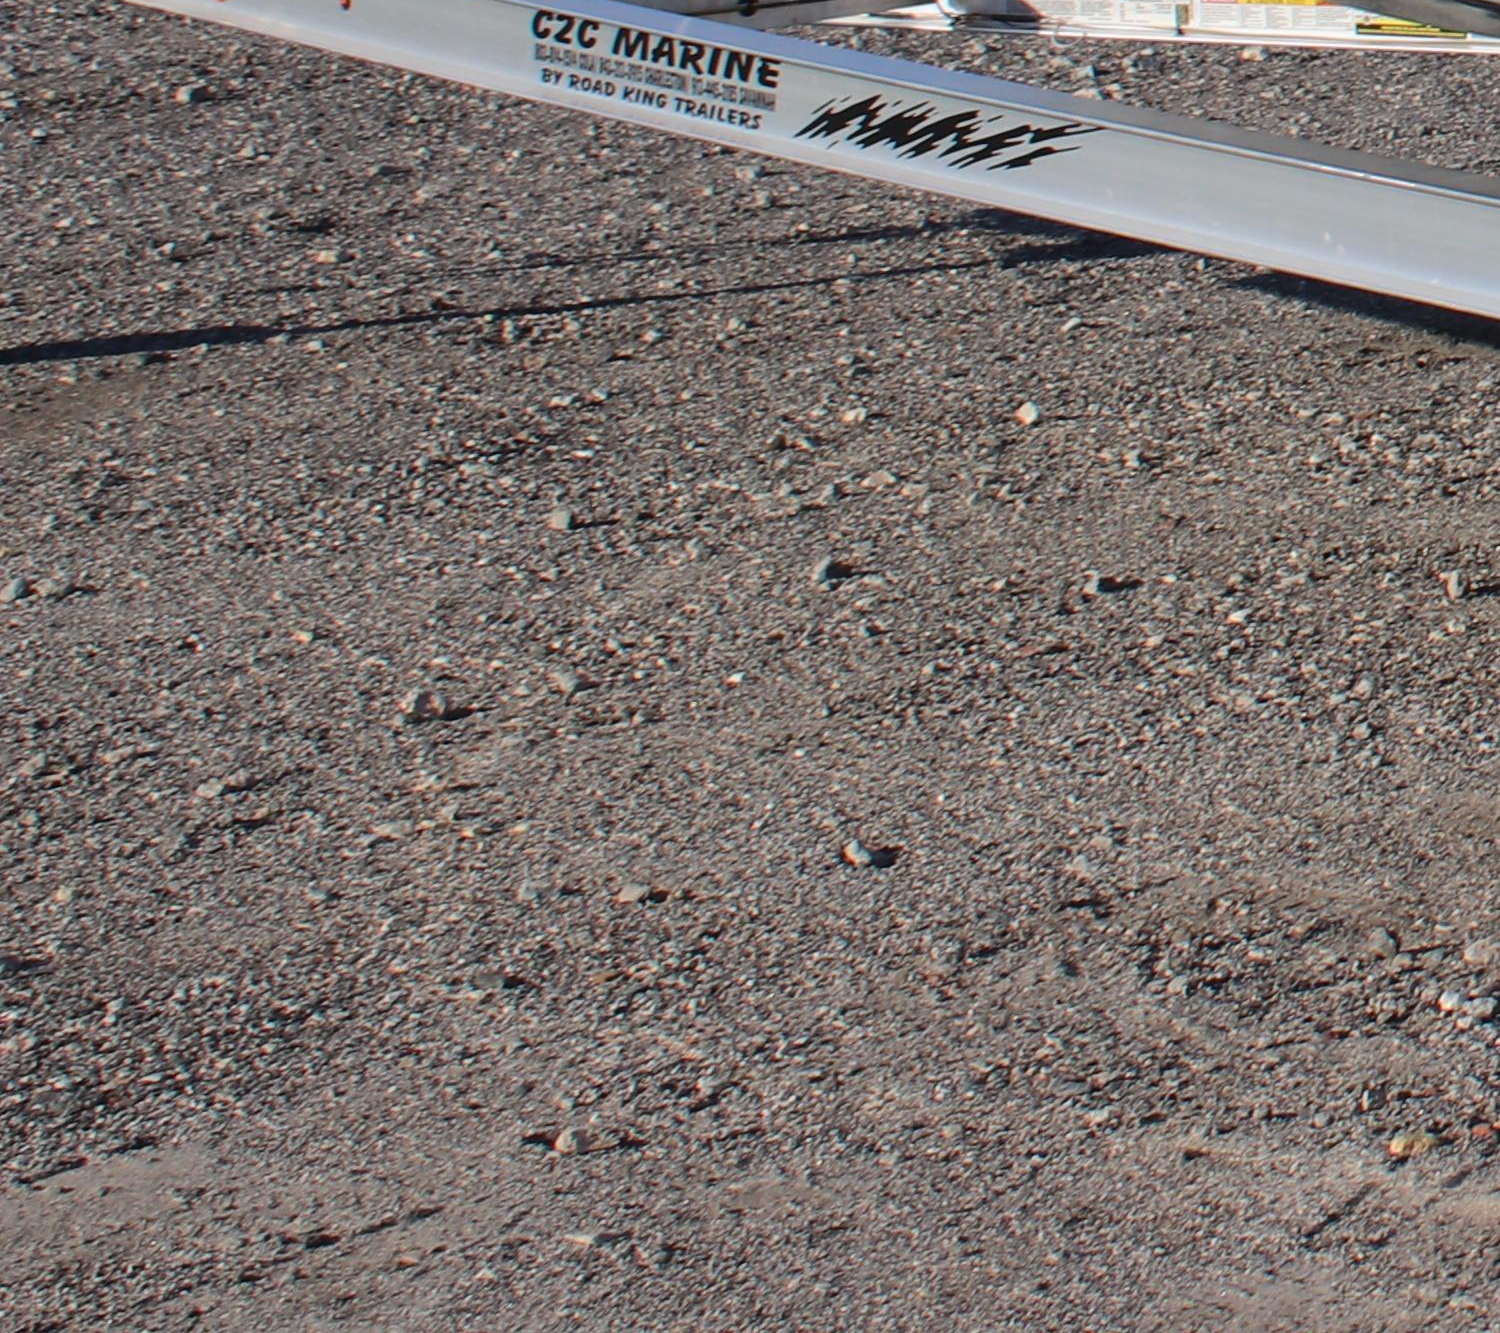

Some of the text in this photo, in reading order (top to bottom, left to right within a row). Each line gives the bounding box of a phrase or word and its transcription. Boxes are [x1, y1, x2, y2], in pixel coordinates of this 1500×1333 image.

[532, 9, 600, 49] C2C
[612, 27, 782, 89] MARINE
[541, 67, 764, 130] BY ROAD KING TRAILERS
